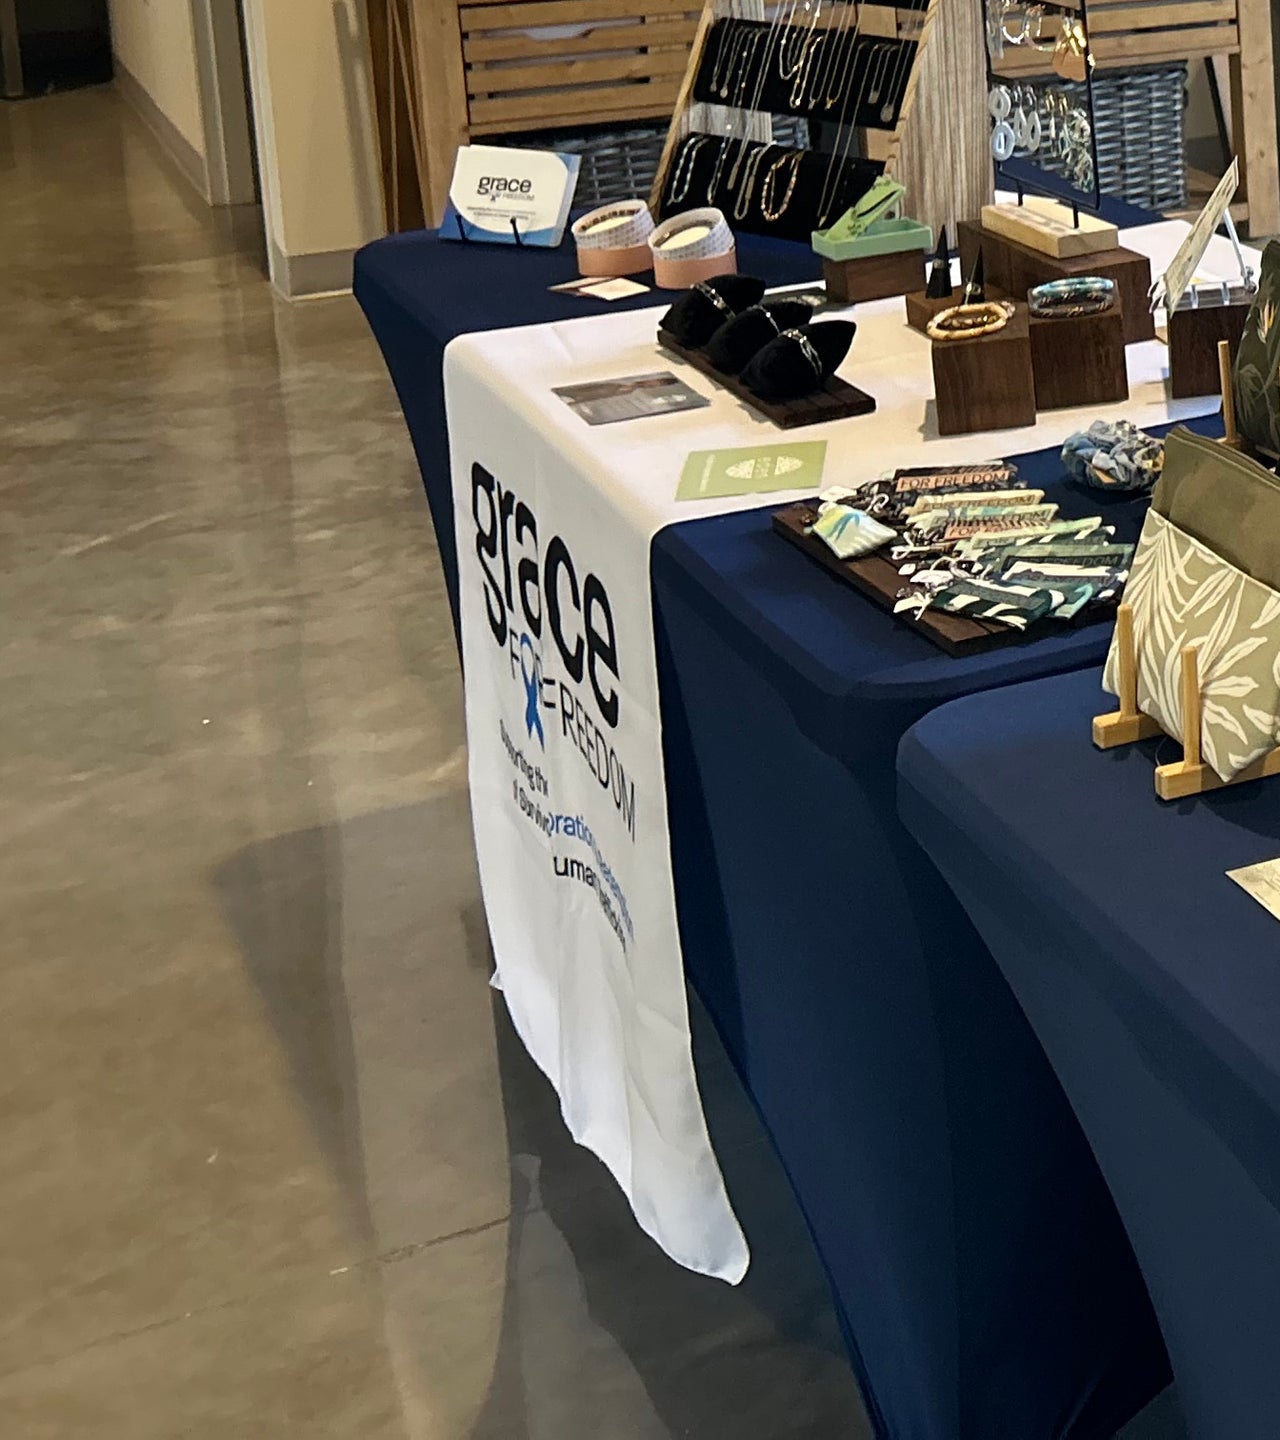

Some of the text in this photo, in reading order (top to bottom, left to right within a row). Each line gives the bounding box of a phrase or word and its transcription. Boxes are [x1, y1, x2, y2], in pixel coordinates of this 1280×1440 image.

[477, 176, 532, 195] grace
[900, 472, 1007, 489] FOR FREEDOM
[472, 461, 620, 728] grace
